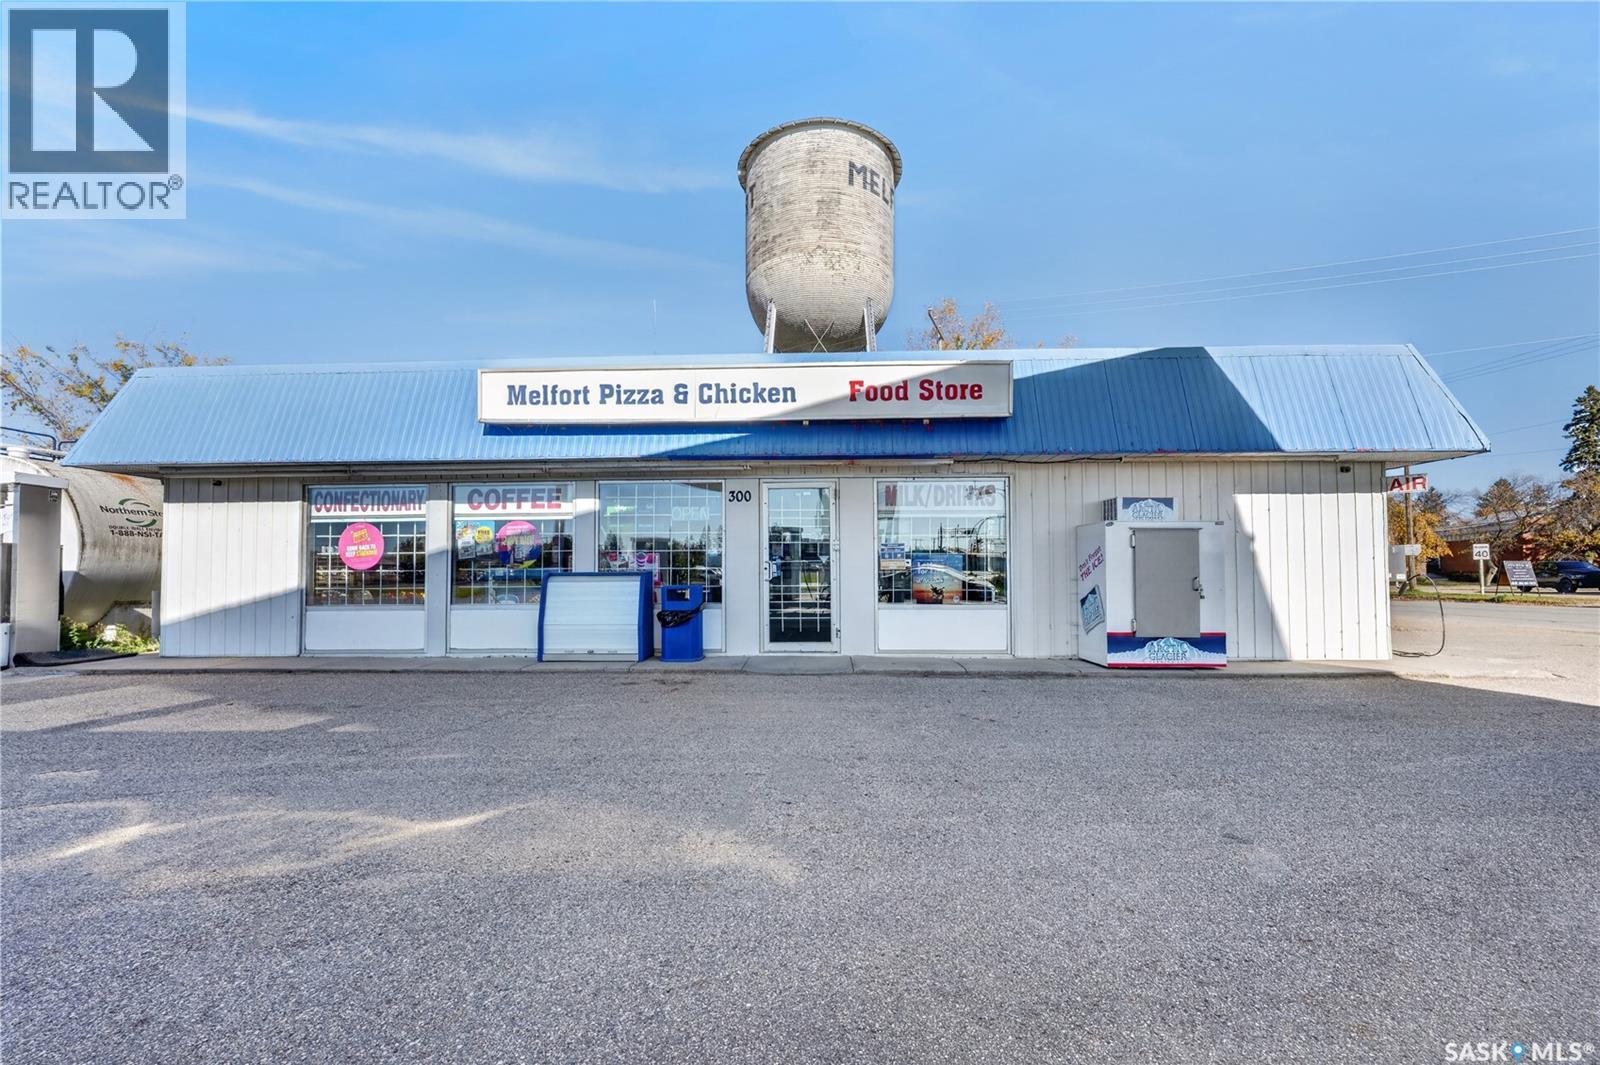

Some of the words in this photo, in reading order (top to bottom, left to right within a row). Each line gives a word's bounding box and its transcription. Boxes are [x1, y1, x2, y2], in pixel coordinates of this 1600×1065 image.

[507, 384, 590, 406] Melfort
[599, 383, 665, 405] Pizza
[673, 383, 689, 405] &
[698, 382, 797, 405] Chicken
[849, 379, 909, 402] Food
[919, 378, 983, 401] Store
[1390, 475, 1427, 491] AIR
[314, 488, 425, 513] CONFECTIONARY
[467, 487, 562, 511] COFFEE
[728, 490, 752, 503] 300
[99, 505, 148, 516] Northern
[671, 506, 710, 521] OPEN
[1474, 550, 1489, 558] 40
[1149, 652, 1187, 661] GLACIER
